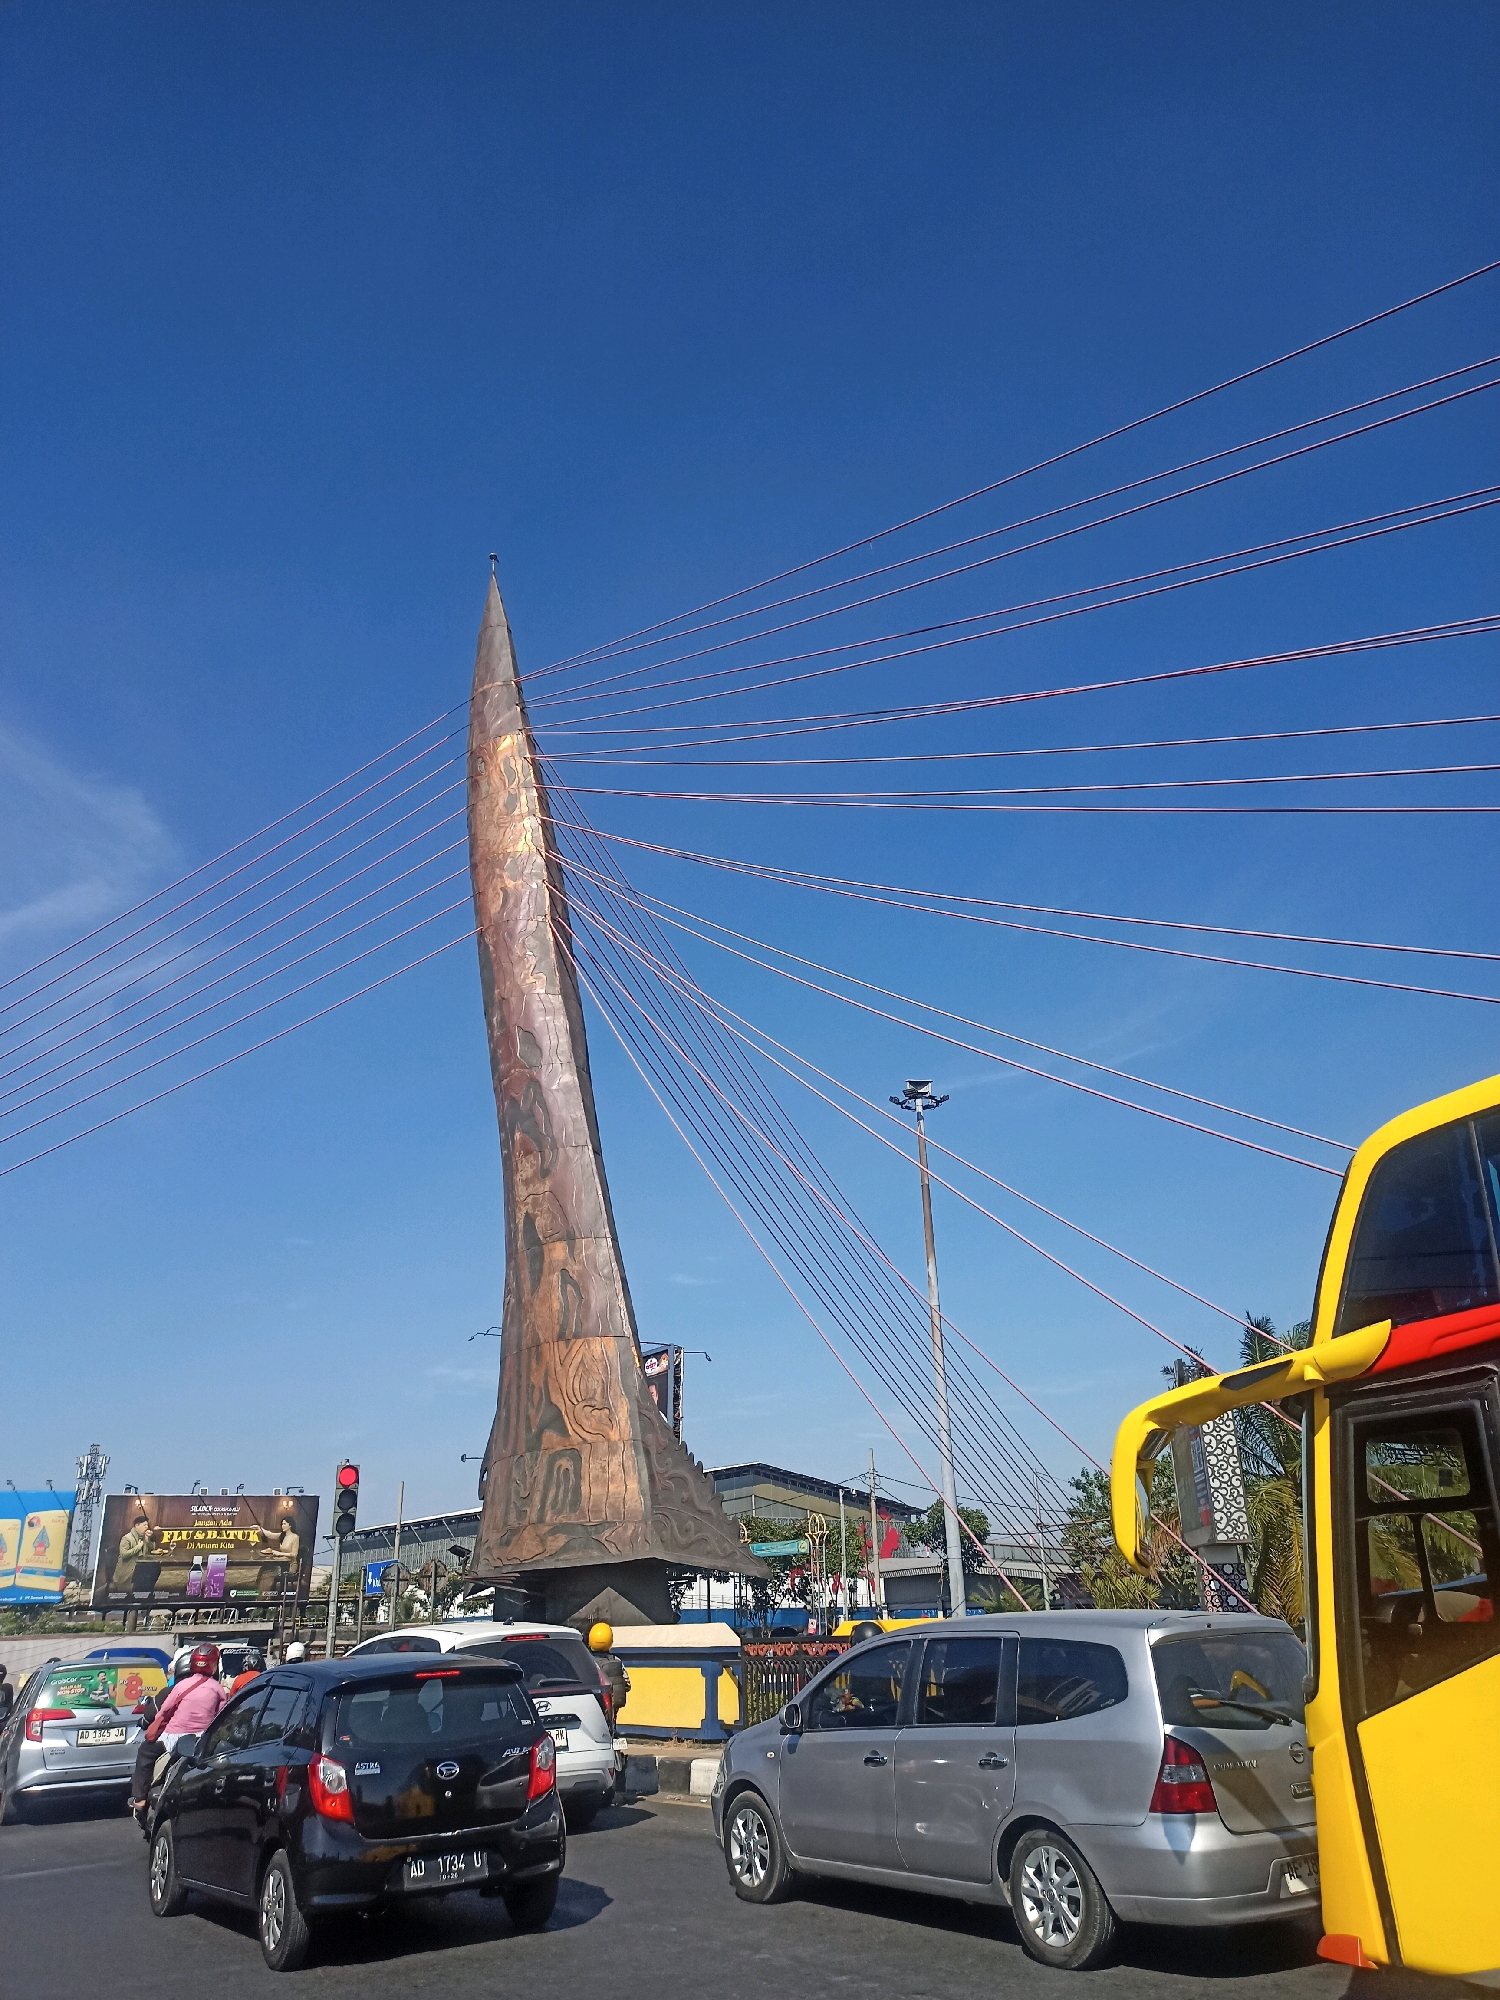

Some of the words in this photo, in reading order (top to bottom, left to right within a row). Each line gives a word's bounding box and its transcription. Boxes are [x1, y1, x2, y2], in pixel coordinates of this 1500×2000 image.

[161, 1530, 193, 1544] FLU
[194, 1530, 206, 1540] &
[206, 1529, 260, 1543] BATUK
[186, 1542, 195, 1550] Di
[219, 1541, 235, 1549] Kita
[124, 1675, 143, 1700] 8
[79, 1730, 90, 1740] AD
[114, 1728, 125, 1738] JA
[356, 1761, 380, 1770] ASTRA
[410, 1859, 426, 1879] AD
[437, 1852, 466, 1874] 1734
[473, 1850, 482, 1868] U
